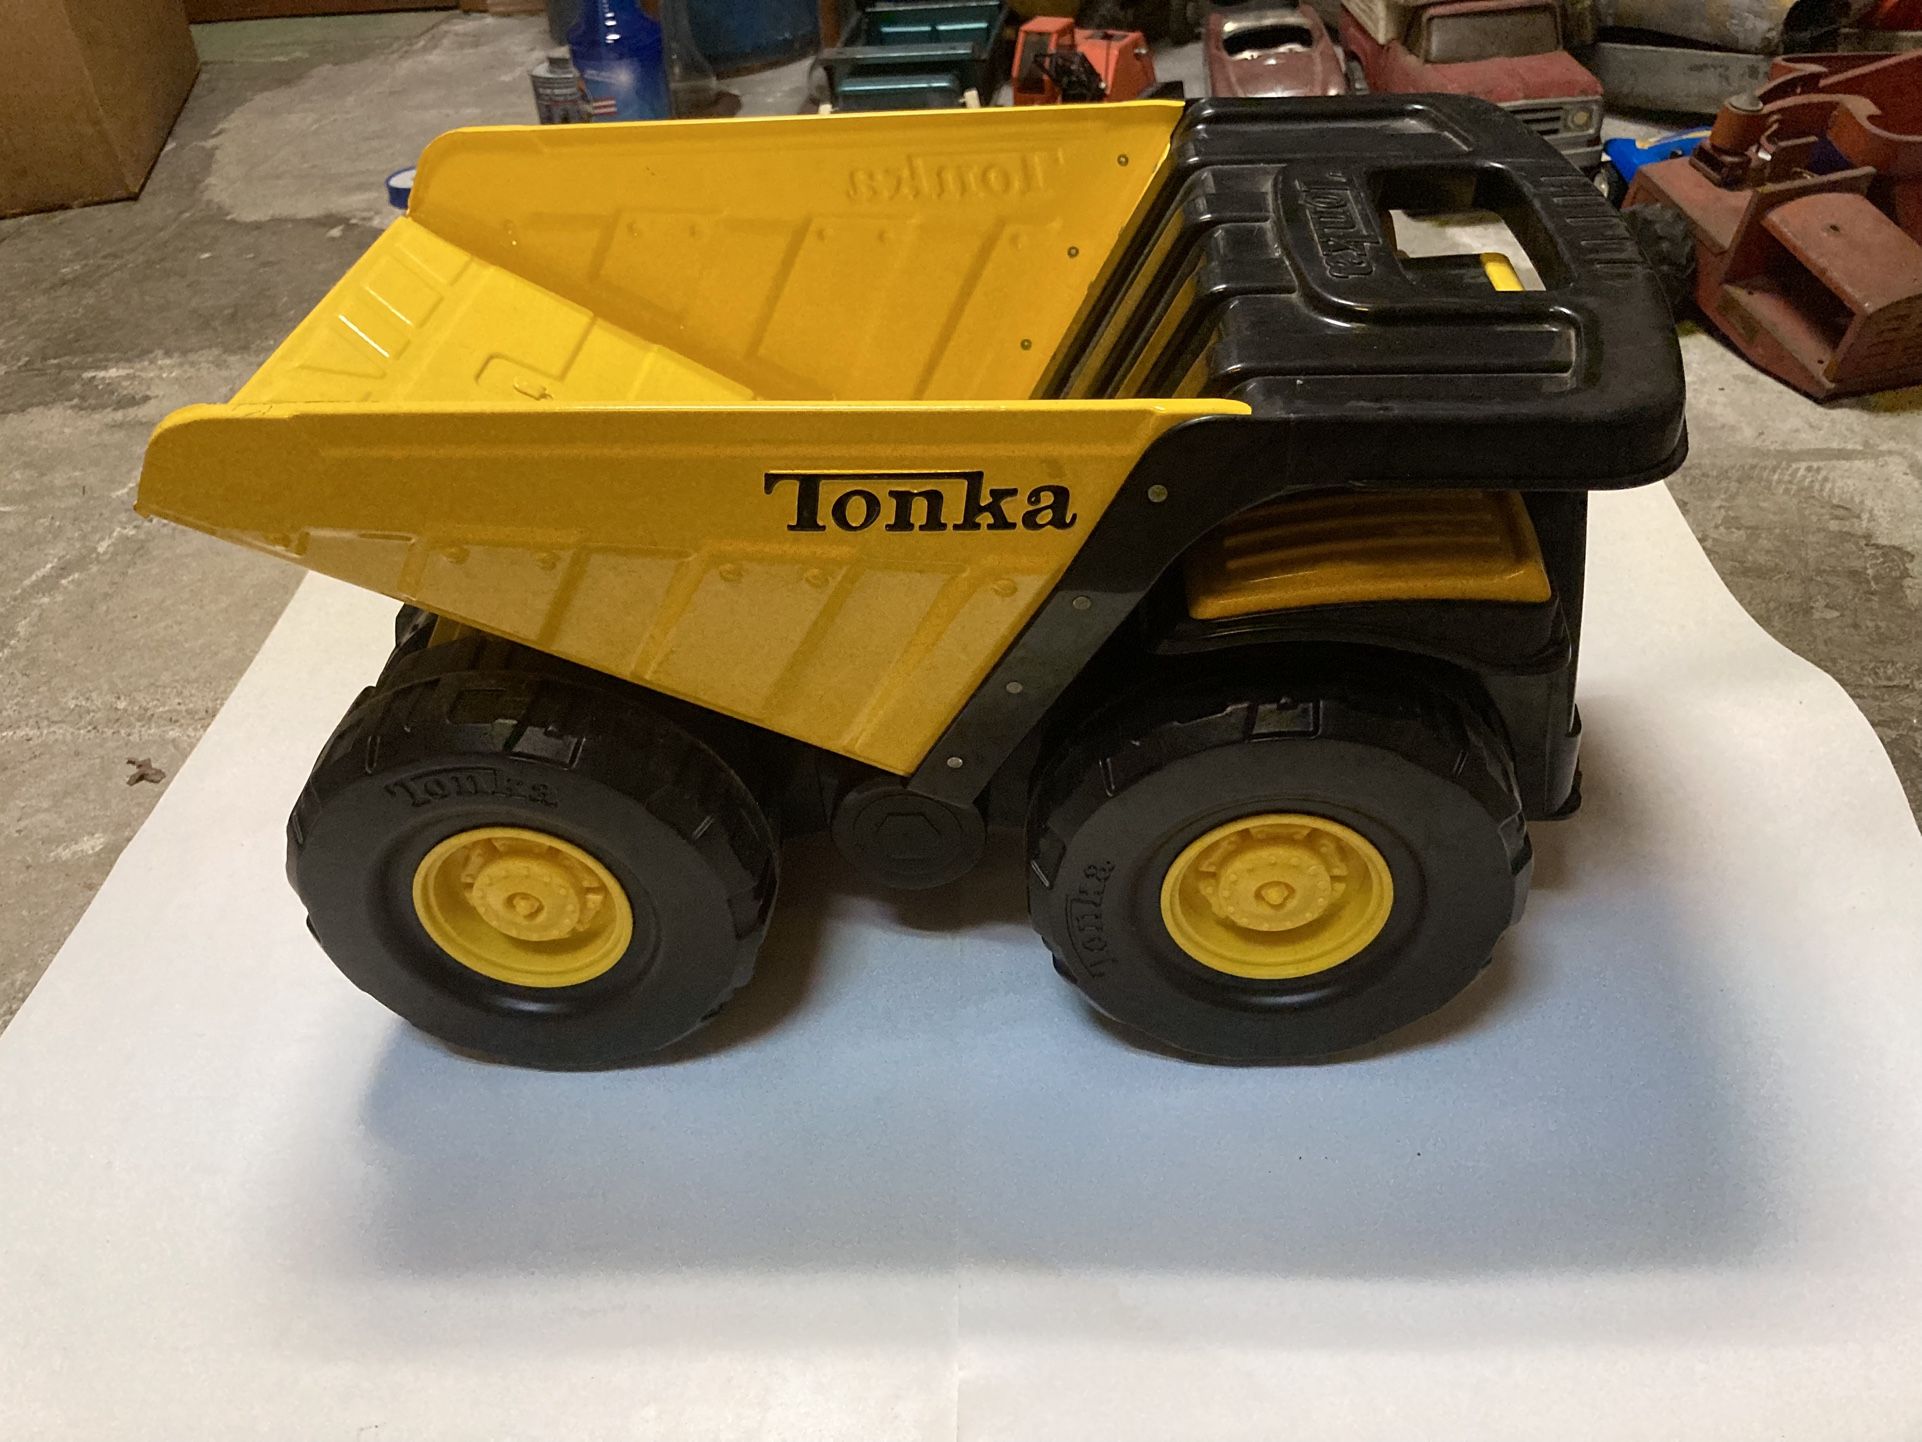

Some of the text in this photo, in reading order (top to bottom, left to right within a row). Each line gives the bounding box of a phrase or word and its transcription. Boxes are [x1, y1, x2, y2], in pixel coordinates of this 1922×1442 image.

[1296, 171, 1382, 279] Tonka
[764, 470, 1078, 532] Tonka
[384, 766, 558, 808] Tonka
[1065, 860, 1118, 978] Tonka
